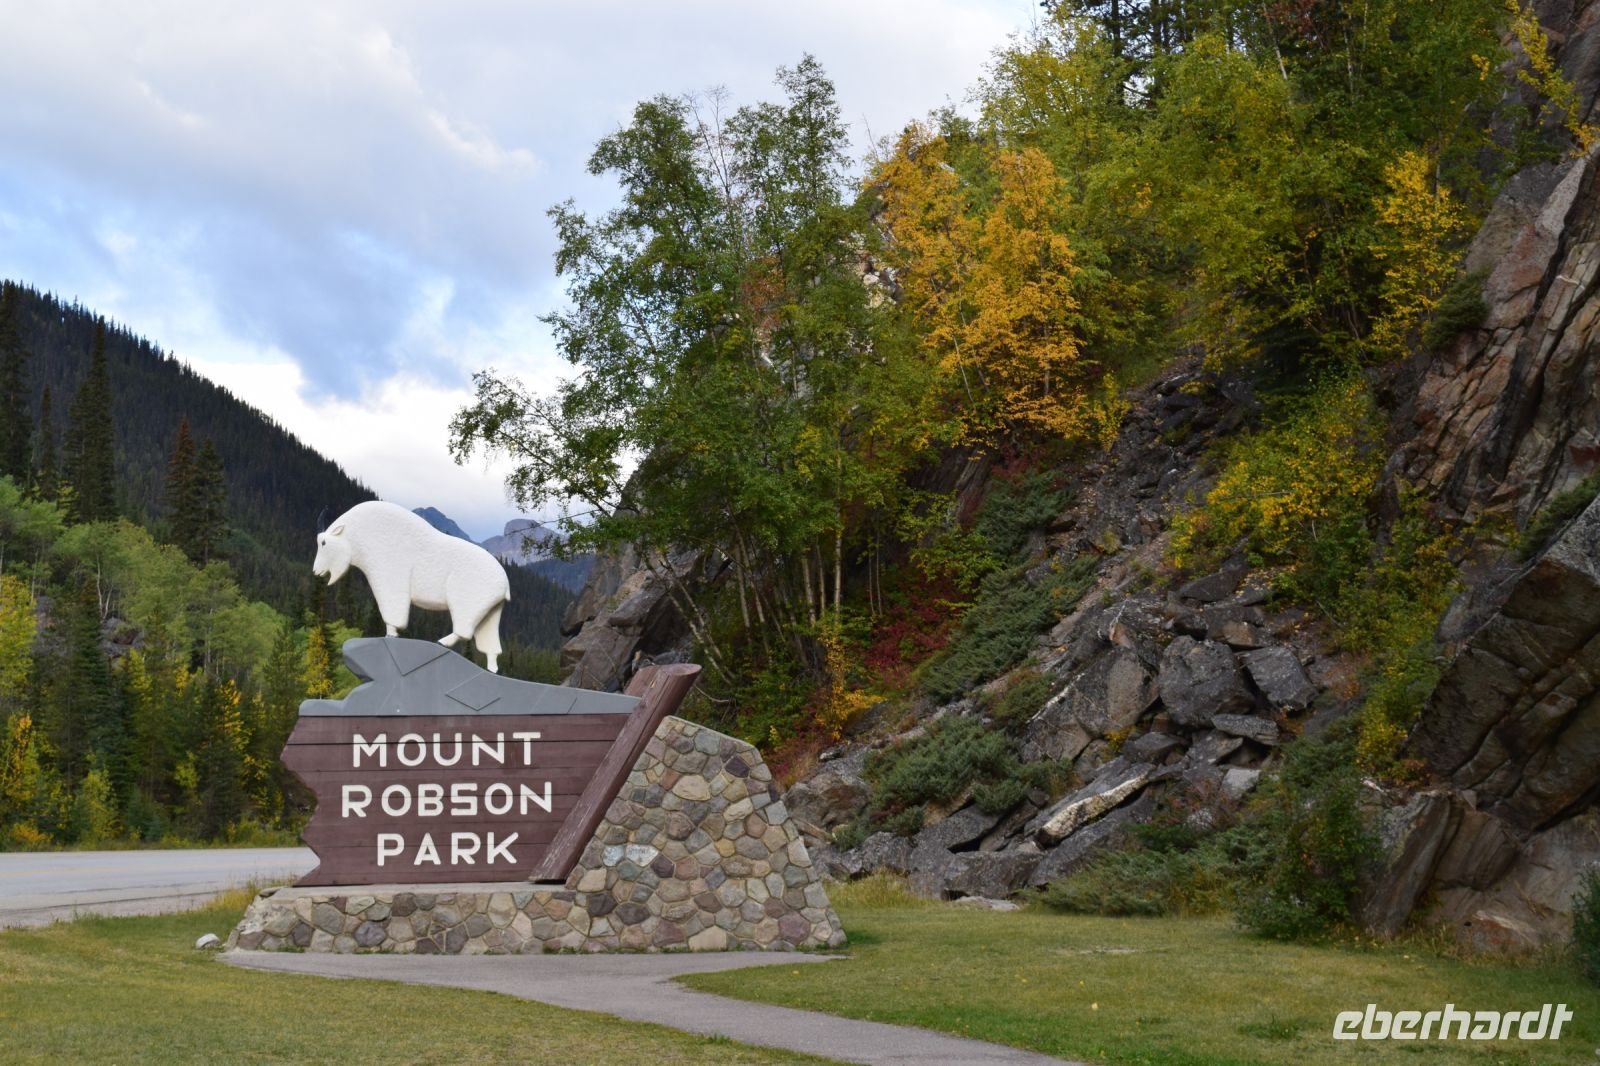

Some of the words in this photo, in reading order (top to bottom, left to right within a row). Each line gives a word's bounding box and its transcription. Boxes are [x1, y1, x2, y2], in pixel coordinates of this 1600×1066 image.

[353, 732, 541, 767] MOUNT
[342, 782, 552, 817] ROBSON
[377, 832, 519, 866] PARK
